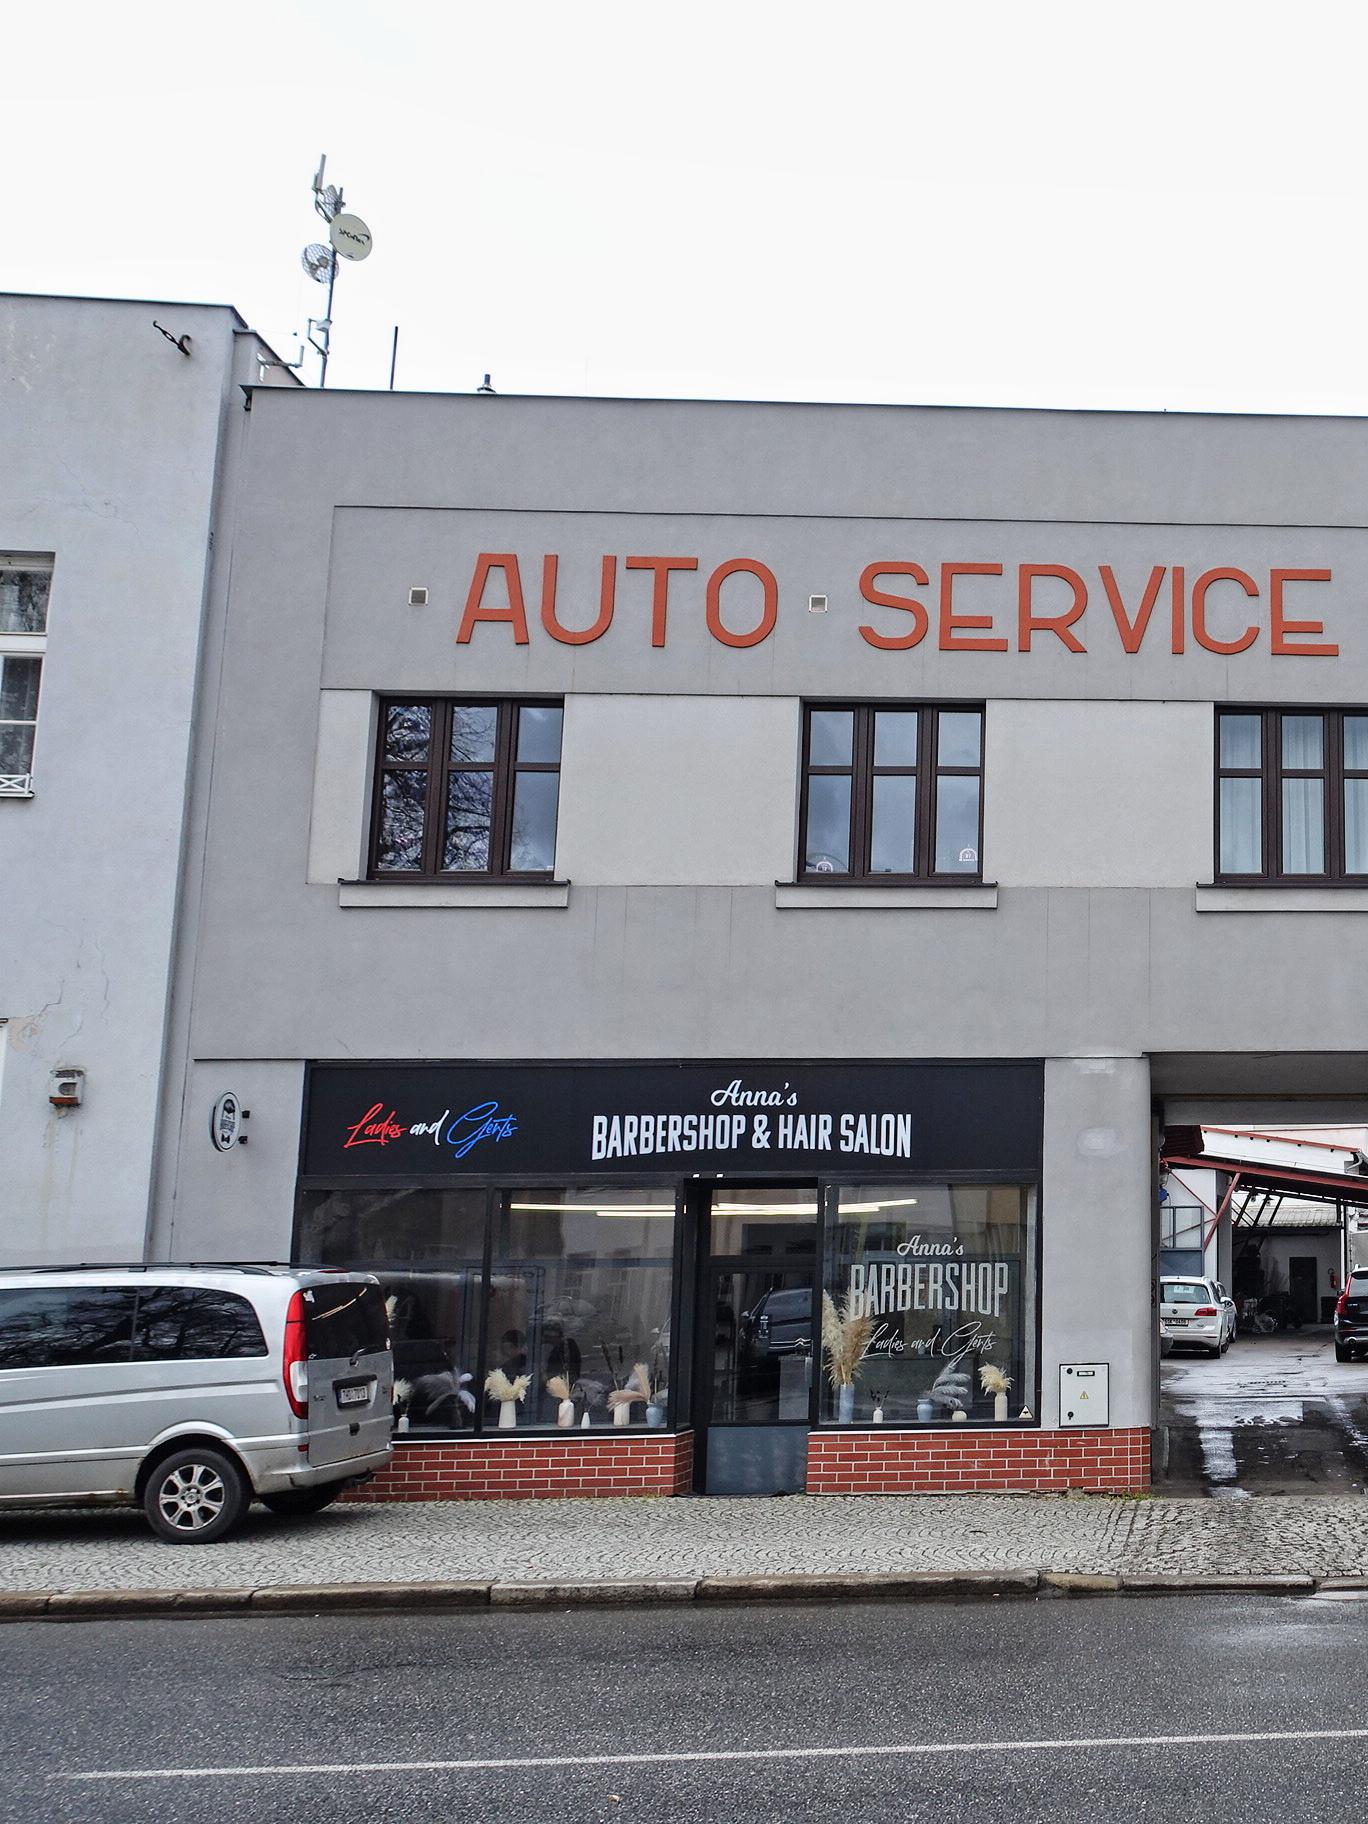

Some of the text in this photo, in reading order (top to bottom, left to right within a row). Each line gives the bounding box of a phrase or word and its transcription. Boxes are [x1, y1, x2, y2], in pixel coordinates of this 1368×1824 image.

[456, 553, 778, 648] AUTO
[858, 561, 1339, 656] SERVICE
[710, 1079, 798, 1106] Anna's
[343, 1101, 519, 1158] Ladies and Gents
[591, 1113, 912, 1160] BARBERSHOP & HAIR SALON
[896, 1234, 964, 1256] Anna's
[850, 1262, 1009, 1321] BARBERSHOP
[910, 1328, 942, 1358] and
